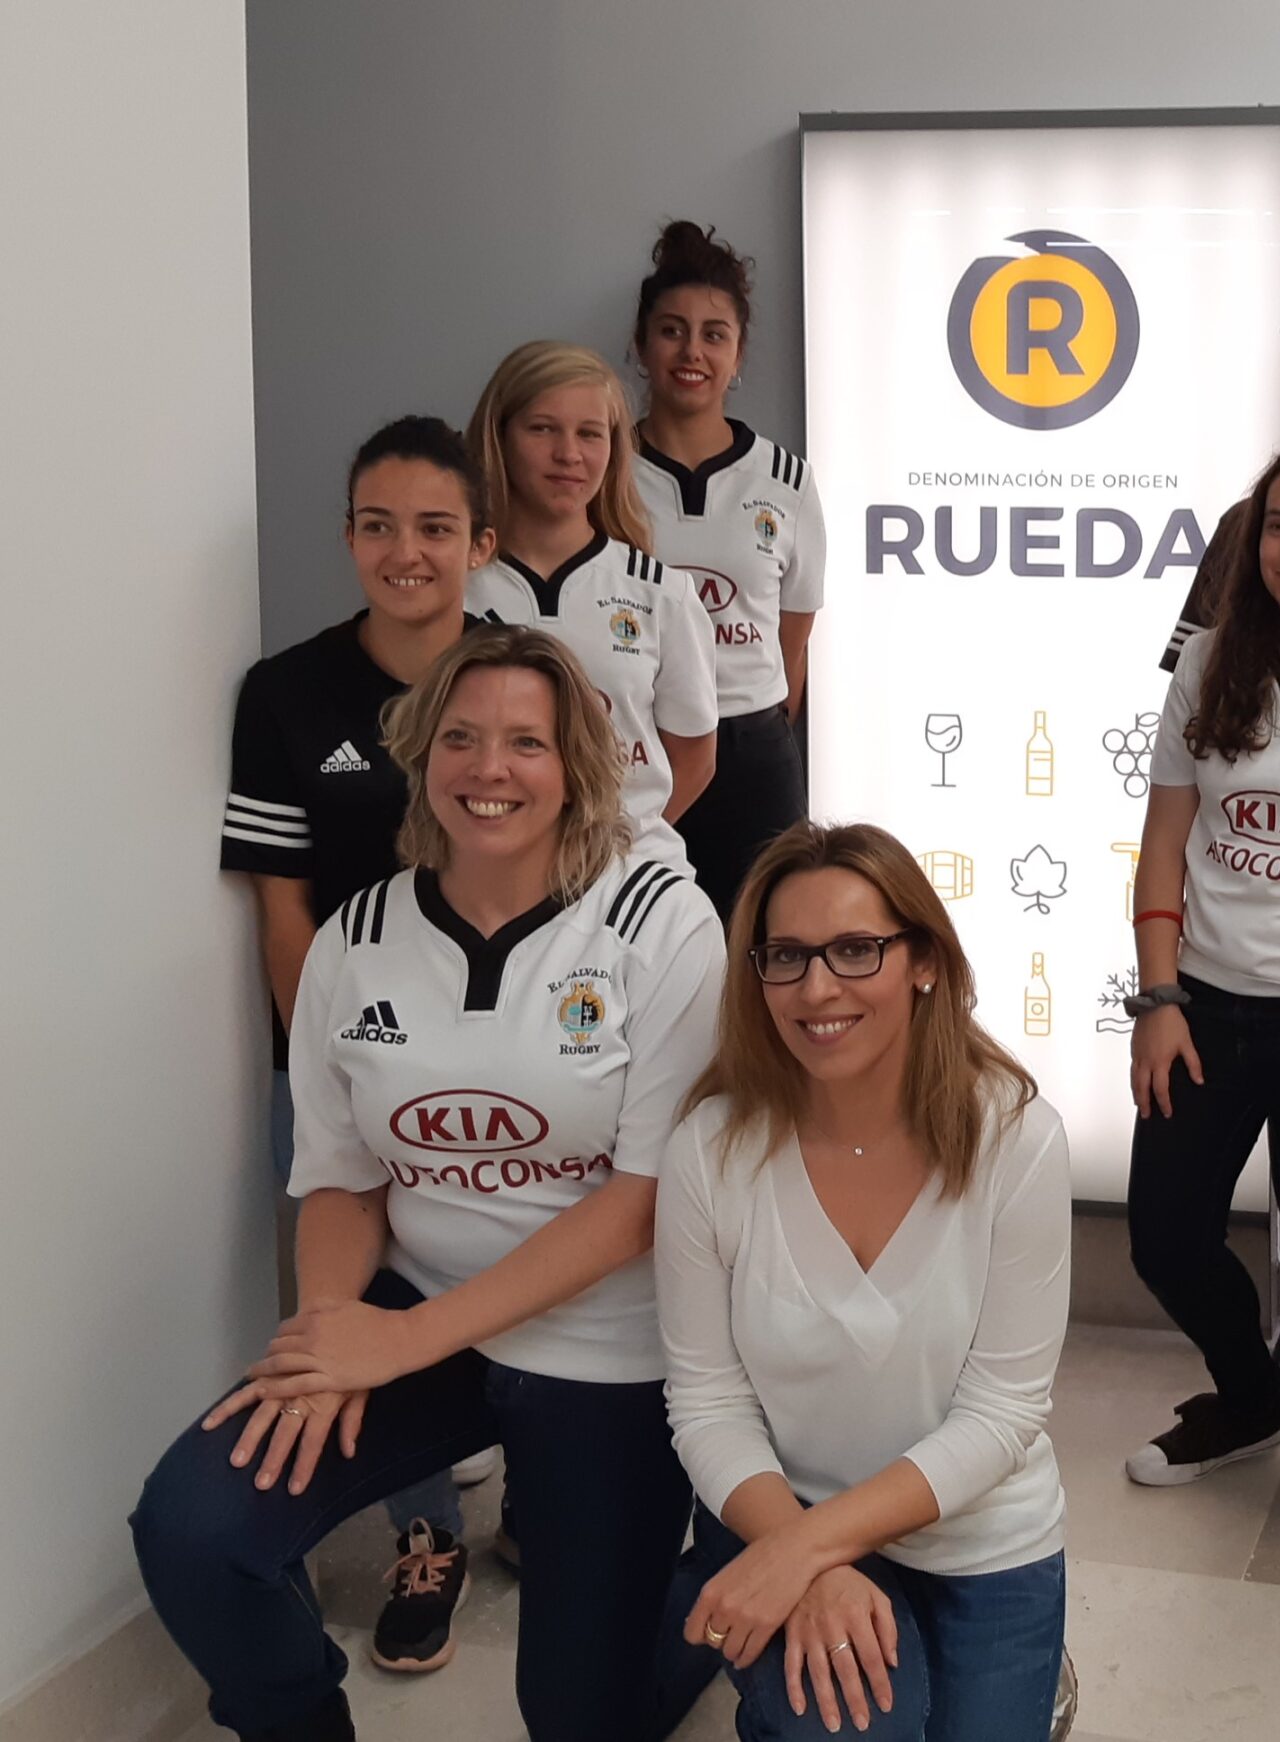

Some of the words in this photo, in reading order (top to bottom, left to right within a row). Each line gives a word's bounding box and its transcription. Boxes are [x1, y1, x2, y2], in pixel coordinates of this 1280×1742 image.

[1006, 280, 1085, 375] R
[908, 470, 1062, 488] DENOMINACIÓN
[1071, 473, 1094, 488] DE
[1102, 473, 1178, 489] ORIGEN
[865, 504, 1208, 579] RUEDA
[320, 758, 371, 774] adidas
[559, 1044, 601, 1055] RUGBY
[415, 1107, 525, 1142] KIA
